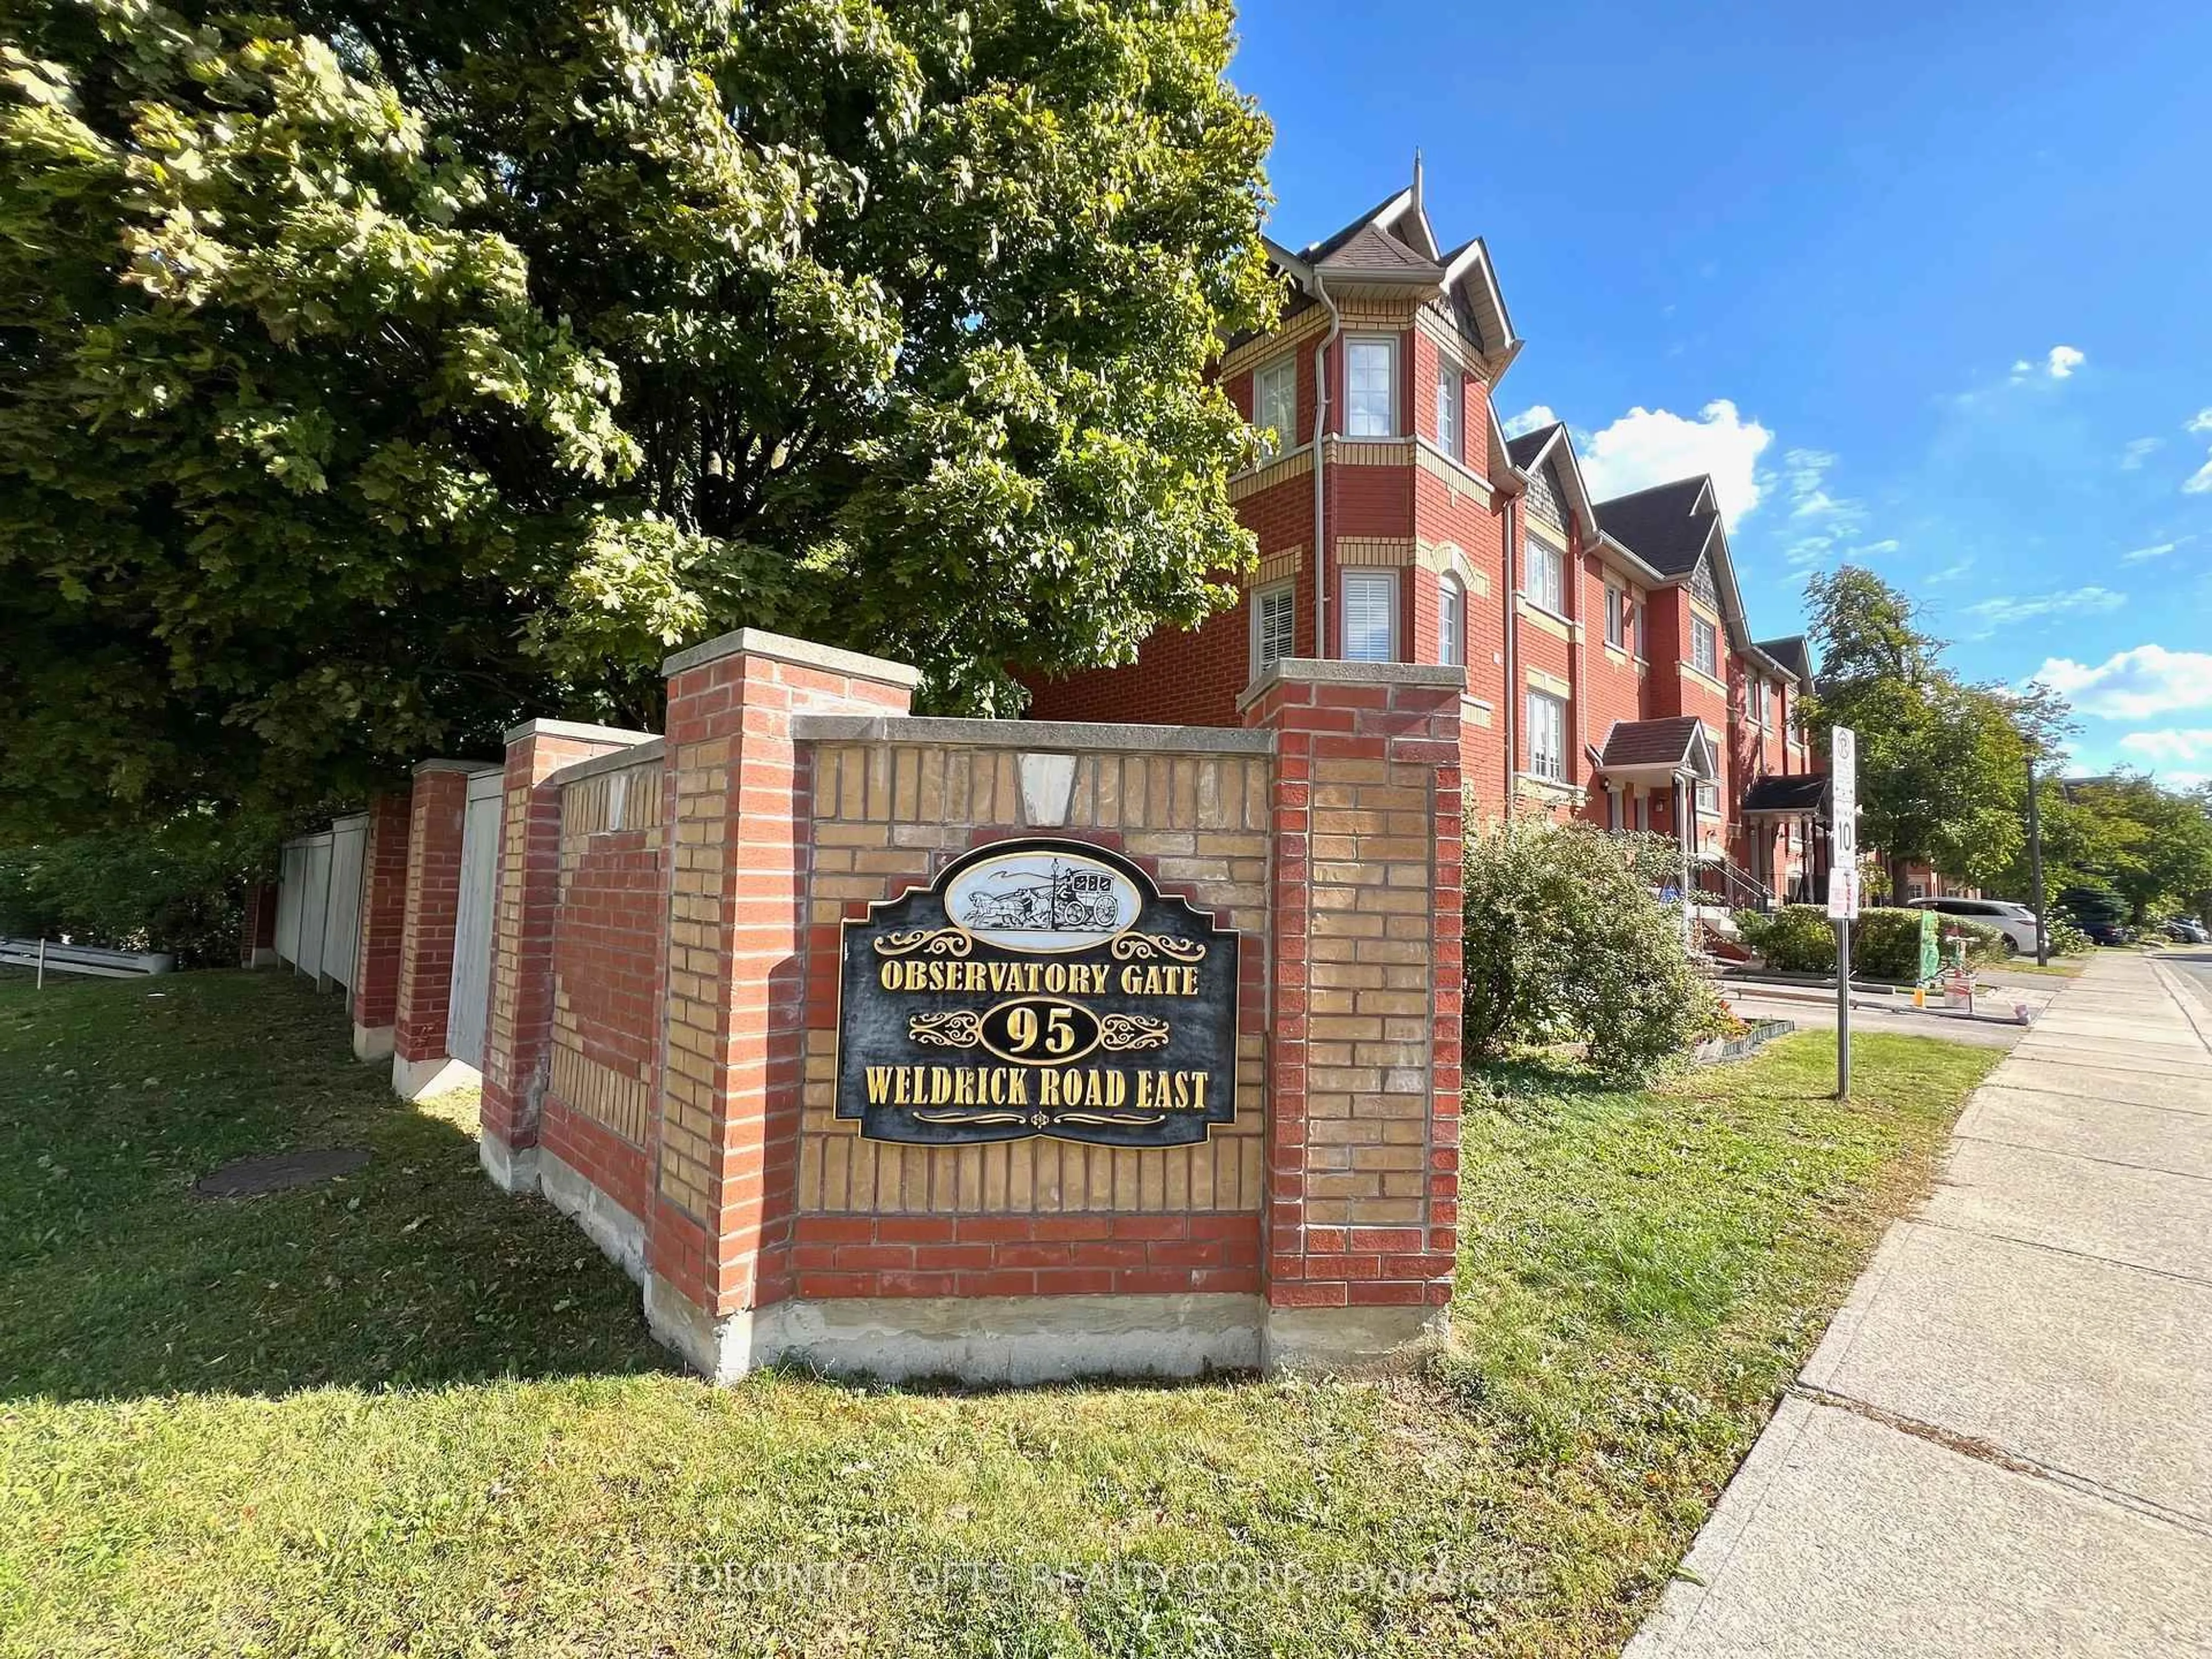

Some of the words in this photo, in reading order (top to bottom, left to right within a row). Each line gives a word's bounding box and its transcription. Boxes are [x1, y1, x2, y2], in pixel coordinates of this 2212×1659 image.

[1838, 820, 1851, 851] 10
[880, 960, 1110, 994] OBSERVATORY
[1120, 964, 1199, 995] GATE
[1006, 1006, 1075, 1054] 95
[865, 1066, 1028, 1106] WELDRICK
[1039, 1068, 1126, 1107] ROAD
[1135, 1069, 1209, 1108] EAST
